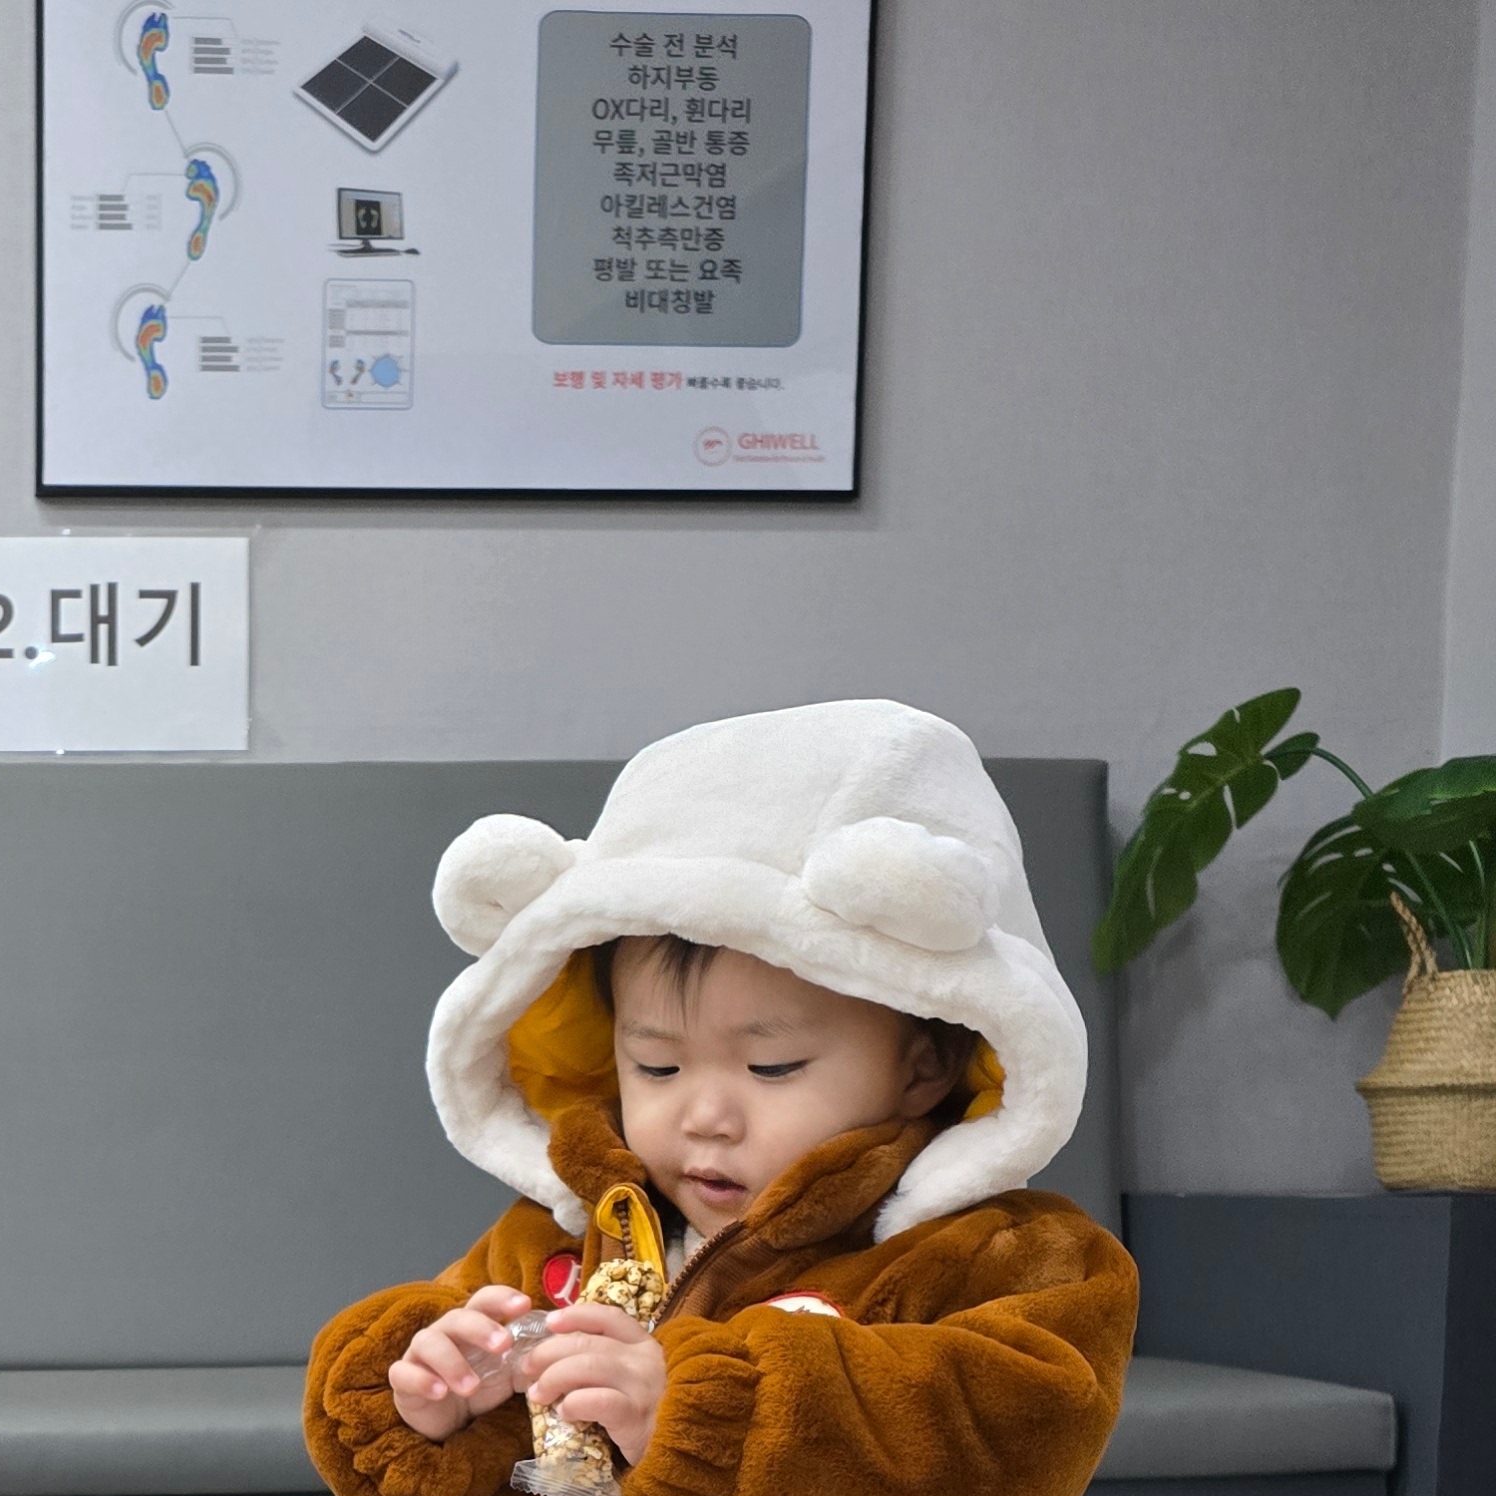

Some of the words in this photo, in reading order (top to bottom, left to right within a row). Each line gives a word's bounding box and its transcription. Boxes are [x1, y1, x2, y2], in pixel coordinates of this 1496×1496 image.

[609, 32, 656, 58] 수술
[663, 33, 685, 59] 전
[693, 33, 739, 60] 분석
[628, 64, 721, 91] 하지부동
[592, 97, 678, 126] OX다리,
[685, 97, 751, 124] 휜다리
[592, 129, 645, 158] 무릎,
[652, 130, 697, 155] 골반
[705, 130, 751, 156] 통증
[613, 162, 727, 188] 족저근막염
[600, 193, 737, 220] 아킬레스건염
[612, 226, 726, 252] 척추측만증
[593, 257, 638, 282] 평발
[644, 258, 690, 282] 또는
[698, 258, 743, 284] 요족
[625, 288, 717, 315] 비대칭발
